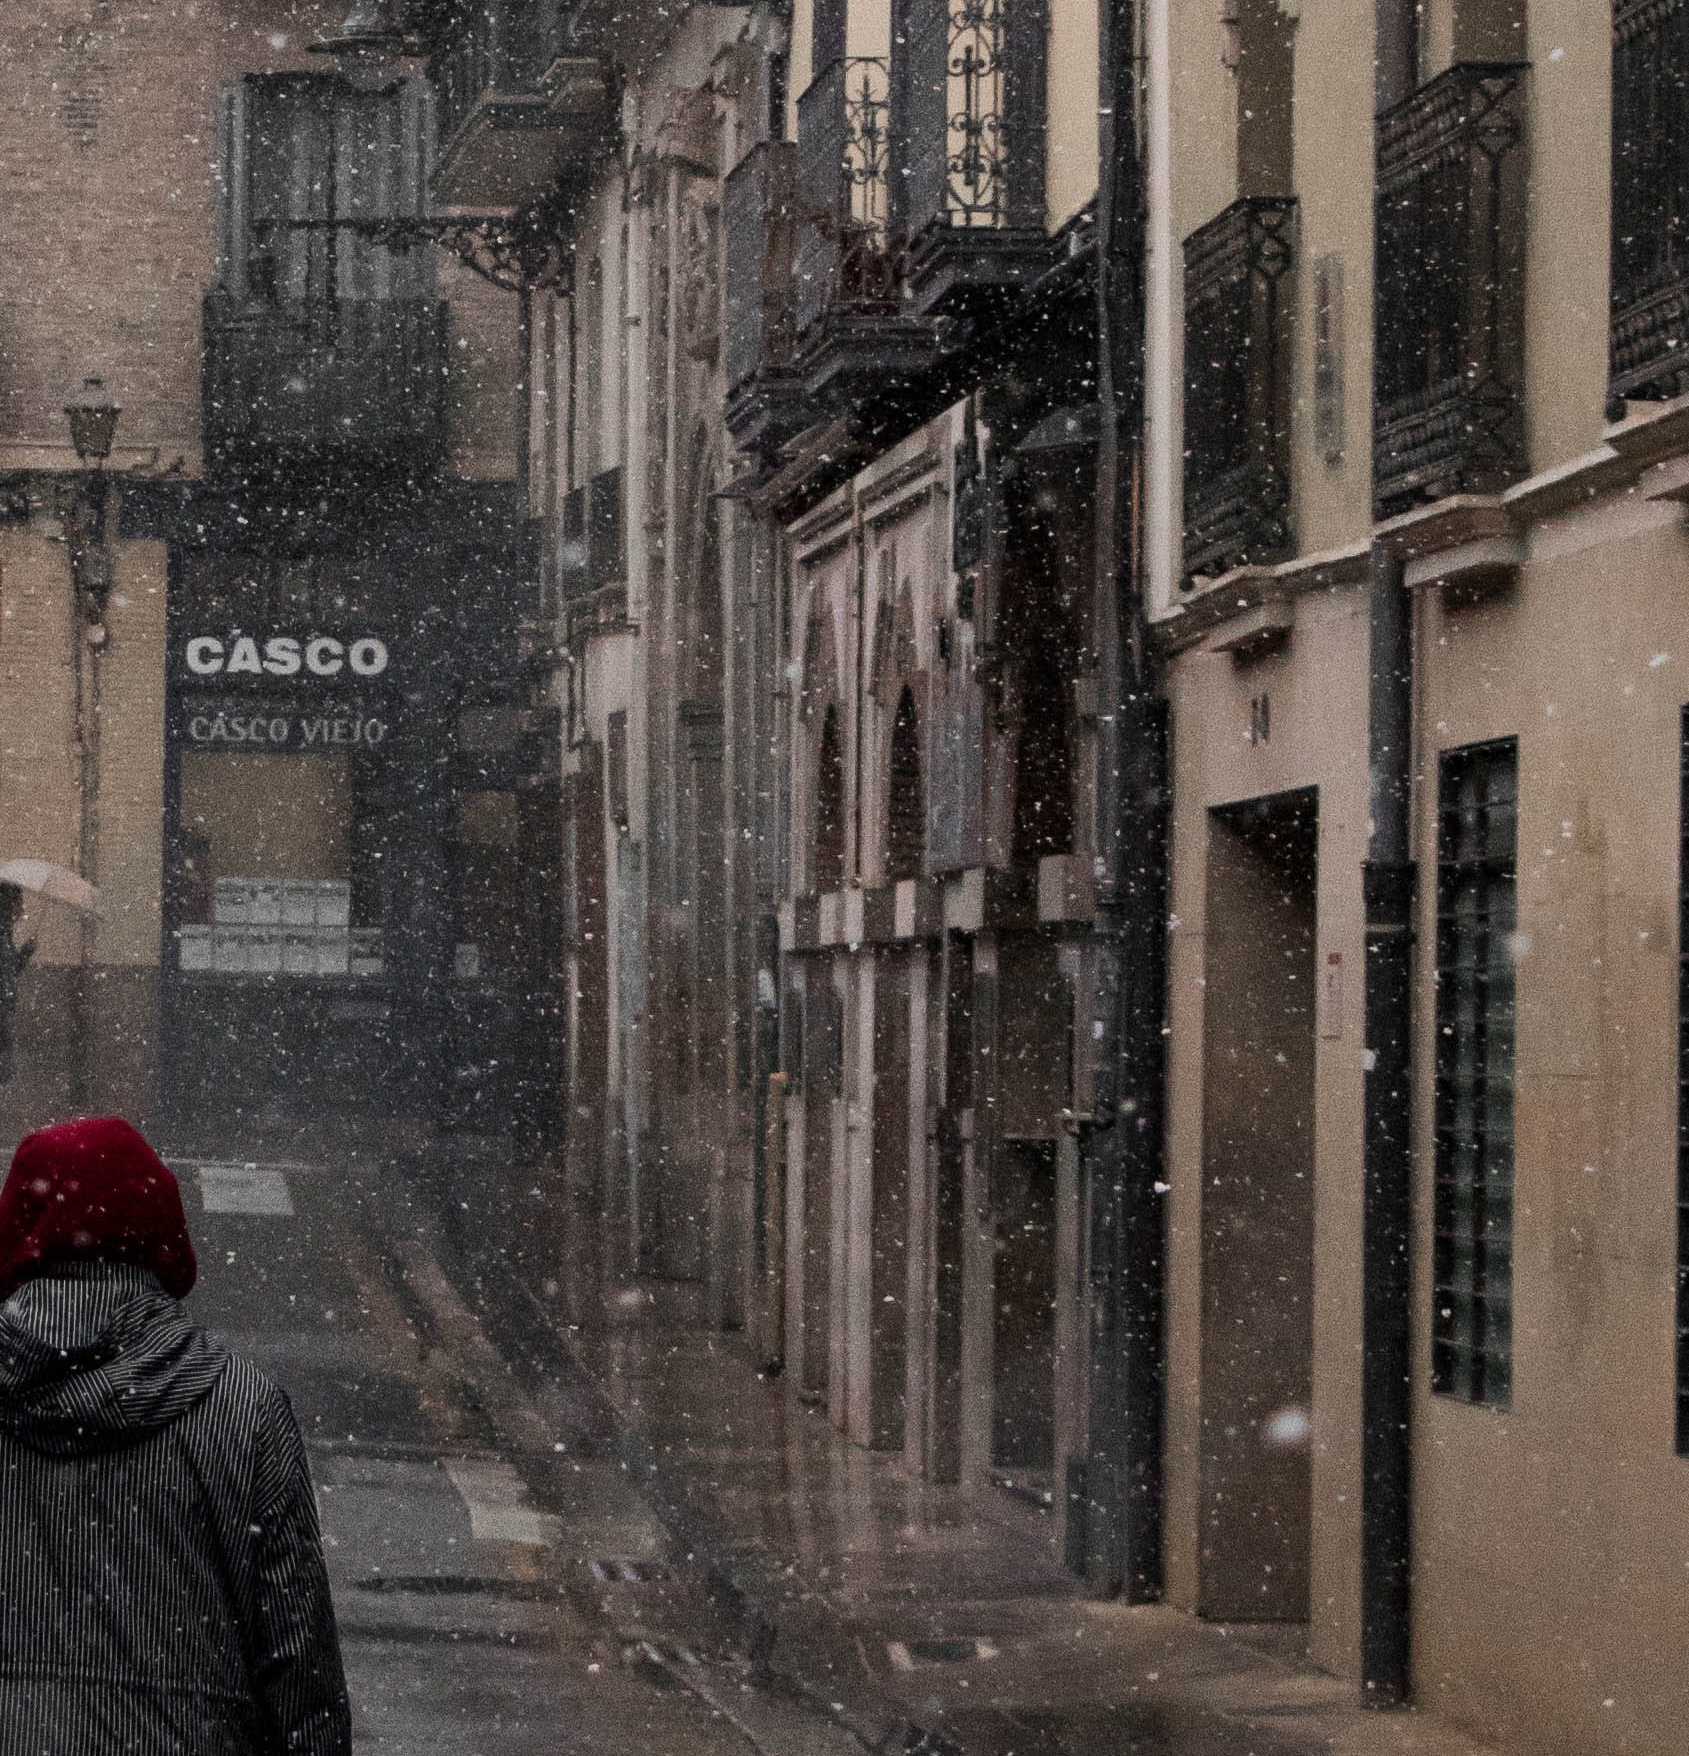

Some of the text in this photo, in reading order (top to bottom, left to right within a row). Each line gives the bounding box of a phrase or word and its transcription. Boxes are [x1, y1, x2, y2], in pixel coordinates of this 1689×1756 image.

[186, 636, 389, 676] CASCO
[191, 717, 386, 744] CASCO VIEJO
